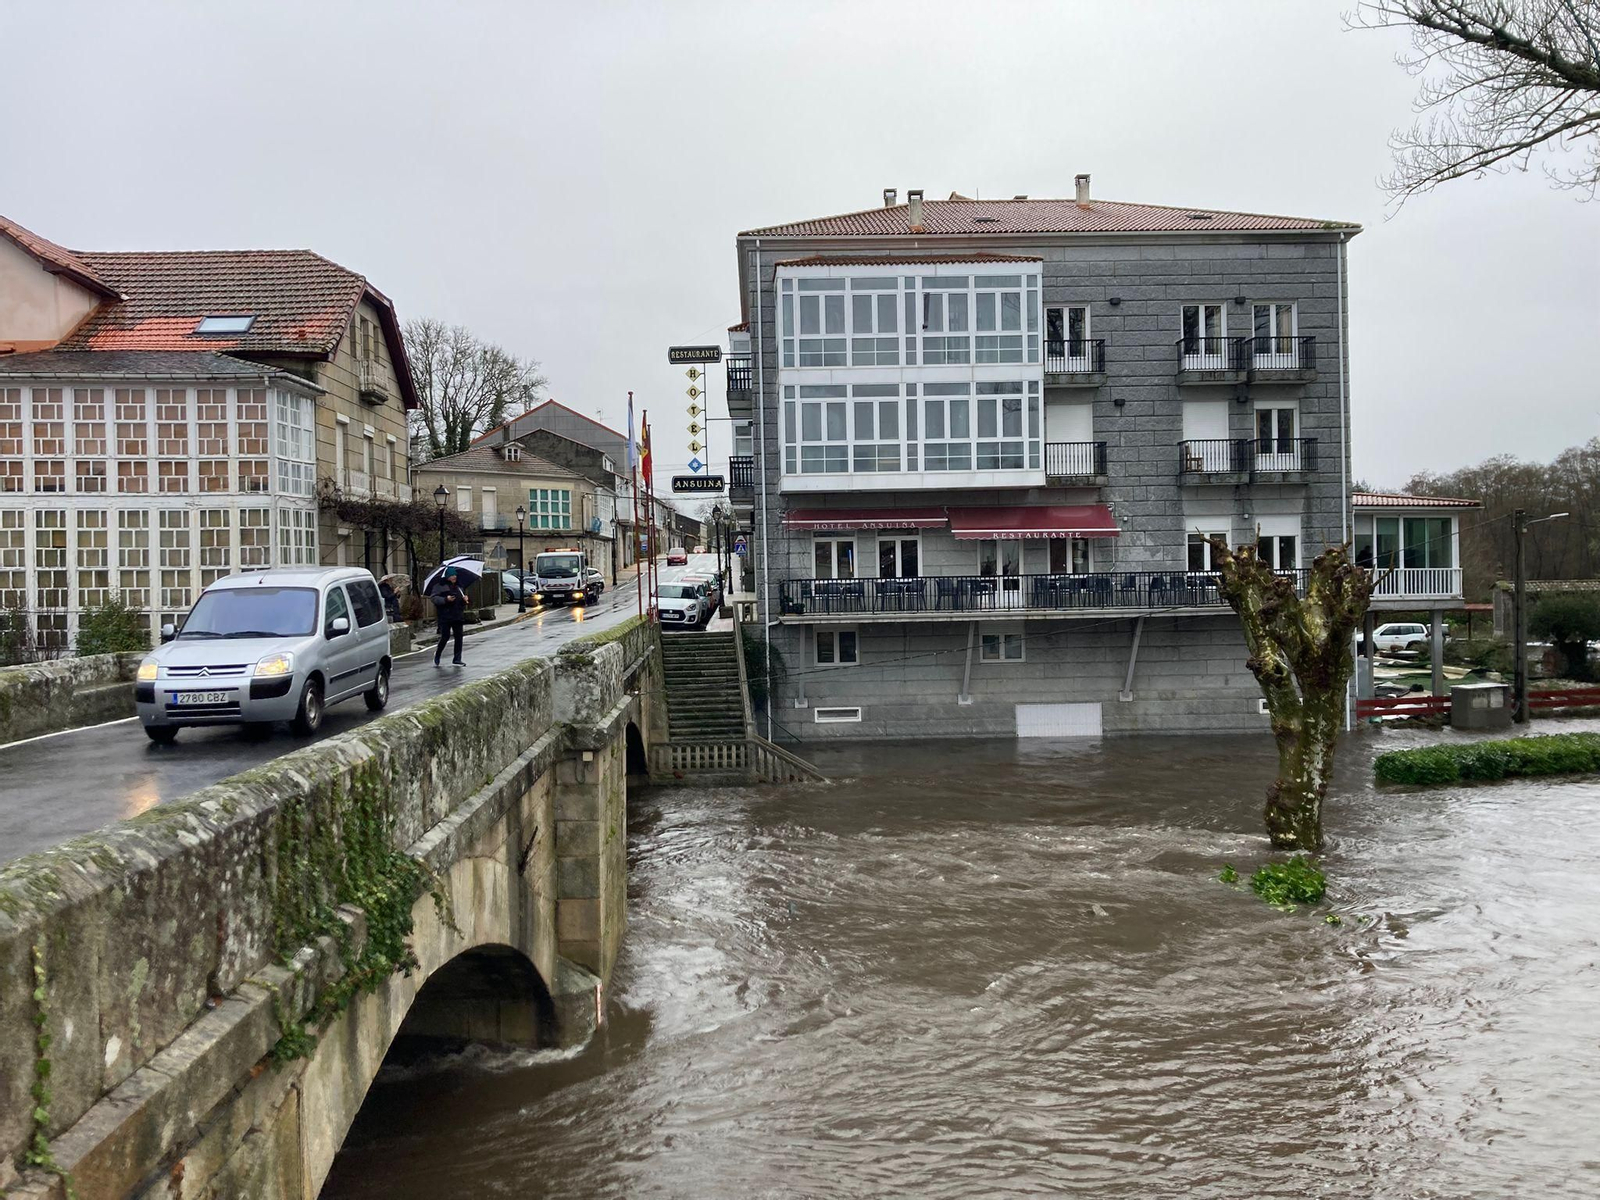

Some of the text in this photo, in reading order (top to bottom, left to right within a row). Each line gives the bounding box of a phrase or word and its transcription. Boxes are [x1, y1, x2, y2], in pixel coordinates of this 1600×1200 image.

[671, 350, 719, 359] RESTAURANTE
[689, 369, 699, 452] HOTEL
[180, 693, 226, 703] 2780 CBZ
